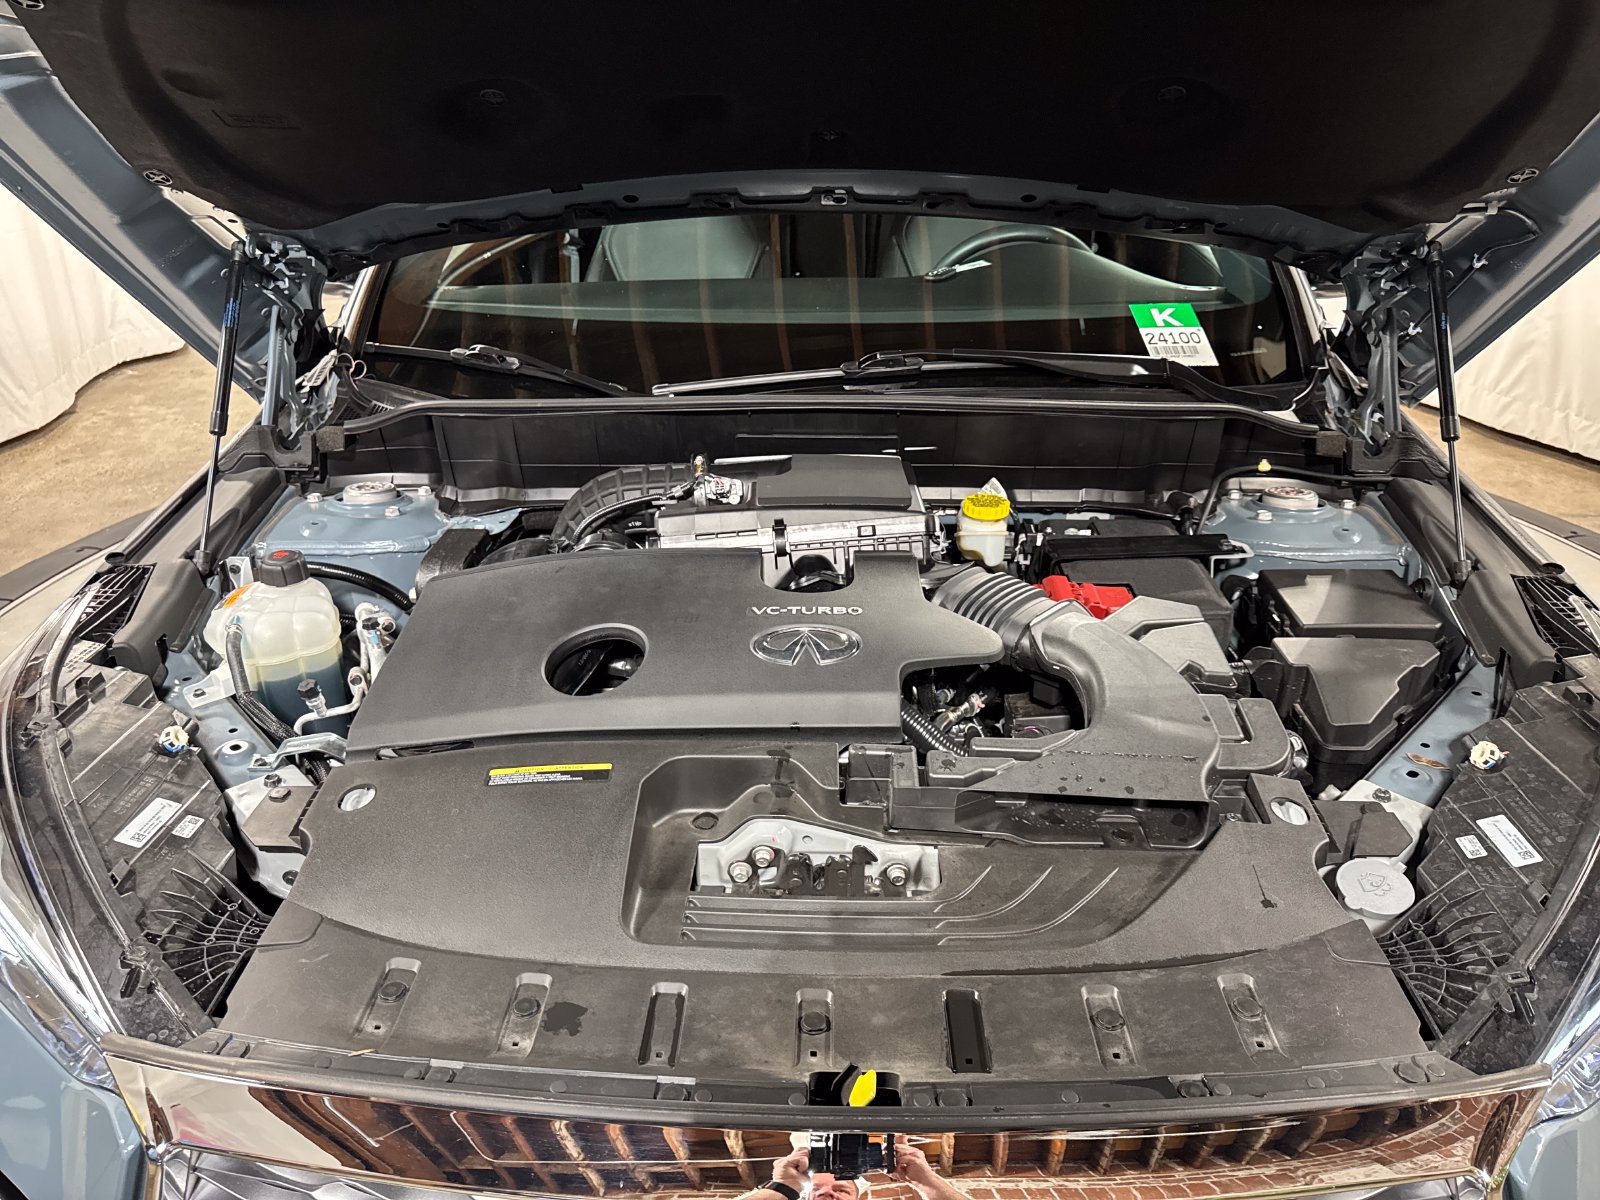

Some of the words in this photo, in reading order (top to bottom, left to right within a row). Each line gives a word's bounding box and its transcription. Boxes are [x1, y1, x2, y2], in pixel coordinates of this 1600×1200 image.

[1150, 308, 1184, 326] K
[1145, 332, 1201, 345] 24100
[751, 606, 863, 615] VC-TURBO
